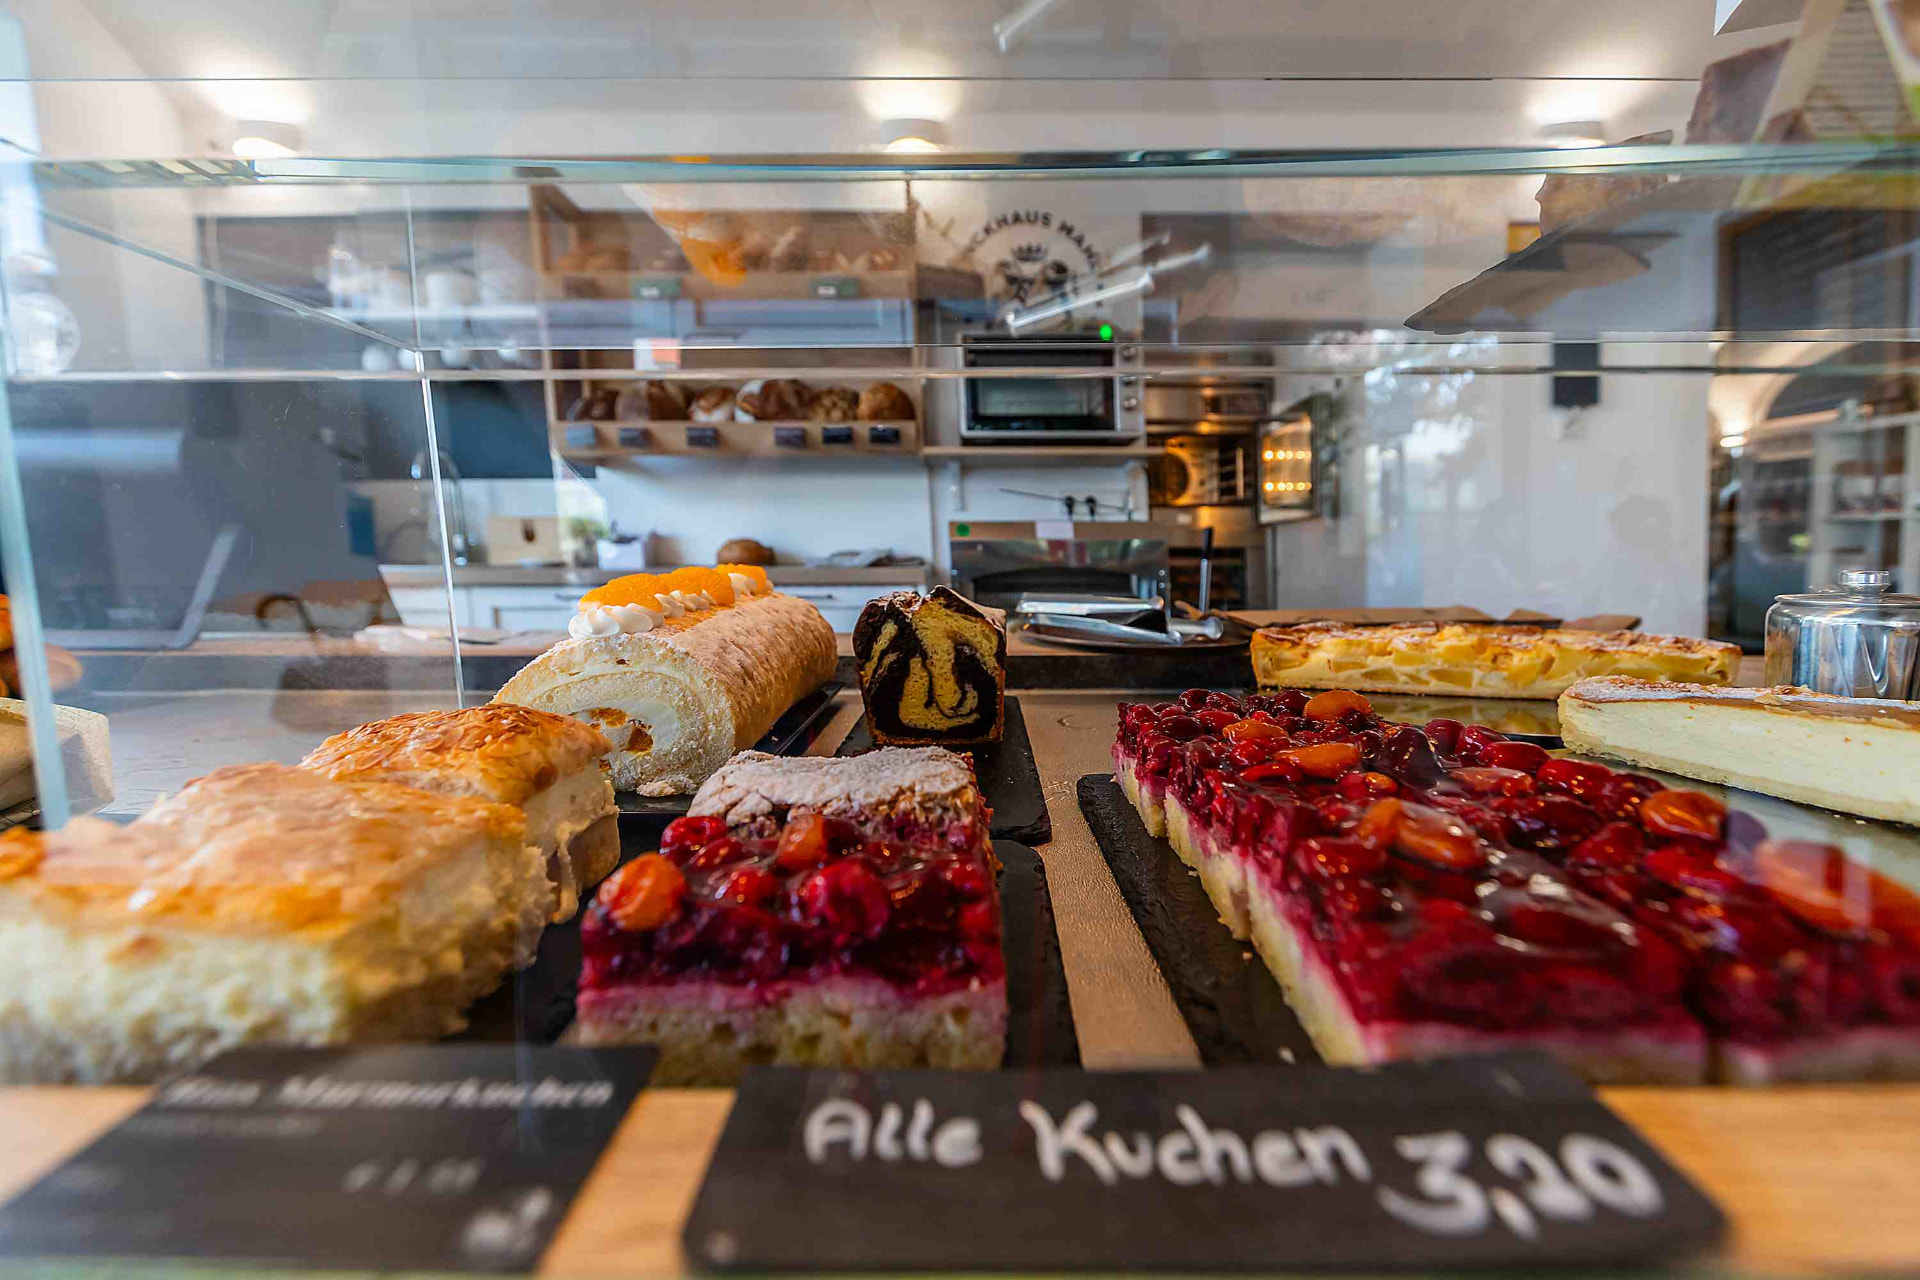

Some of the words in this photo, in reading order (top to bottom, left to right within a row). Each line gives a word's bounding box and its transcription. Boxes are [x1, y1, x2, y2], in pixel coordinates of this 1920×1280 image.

[963, 209, 1053, 253] CKHAUS
[804, 1097, 984, 1168] Alle
[1018, 1099, 1372, 1187] Kuchen
[1374, 1130, 1664, 1241] 3,20
